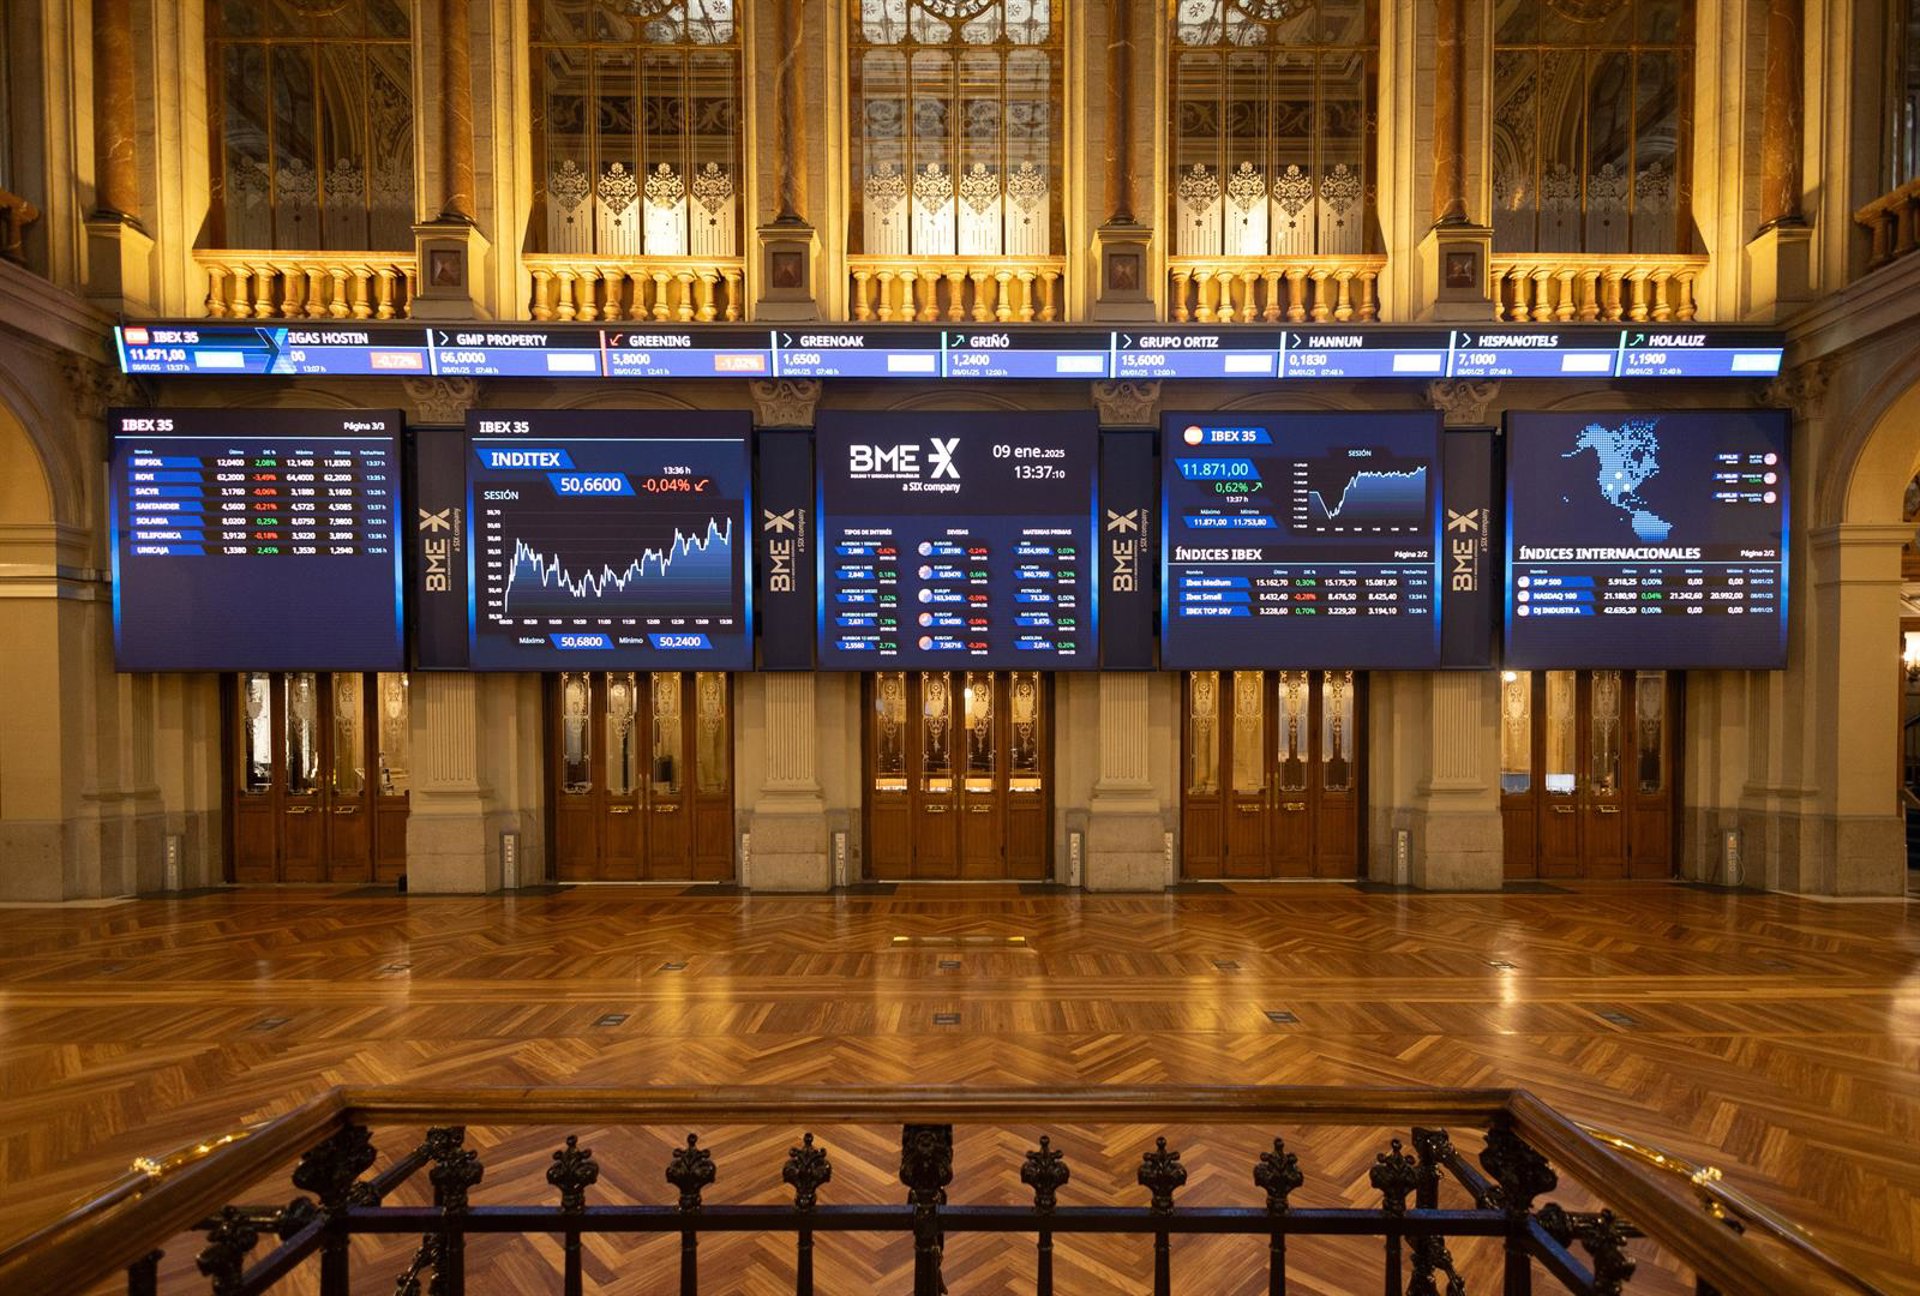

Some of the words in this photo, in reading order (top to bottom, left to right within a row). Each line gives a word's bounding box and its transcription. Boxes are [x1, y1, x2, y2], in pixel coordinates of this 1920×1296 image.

[153, 331, 182, 343] IBEX
[184, 331, 199, 343] 35
[322, 332, 368, 344] HOSTIN
[457, 334, 484, 345] GMP
[487, 334, 547, 346] PROPERTY
[629, 335, 690, 347] GREENING
[800, 335, 864, 347] GREENOAK
[970, 334, 1009, 348] GRIÑÓ
[1140, 336, 1181, 348] GRUPO
[1184, 336, 1218, 348] ORTIZ
[1309, 336, 1363, 348] HANNUN
[1479, 335, 1558, 347] HISPANOTELS
[1649, 335, 1705, 346] HOLALUZ
[130, 349, 186, 362] 11.871,00
[440, 352, 486, 364] 66,0000
[613, 353, 650, 365] 5,8000
[784, 353, 820, 366] 1,6500
[953, 354, 990, 366] 1,2400
[1121, 355, 1164, 367] 15,6000
[1290, 354, 1326, 366] 0,1830
[1459, 353, 1496, 366] 7,1000
[1628, 353, 1666, 365] 1,1900
[122, 419, 155, 431] IBEX
[157, 419, 173, 431] 35
[344, 422, 370, 432] Página
[372, 422, 385, 430] 3/3
[480, 421, 511, 433] IBEX
[513, 421, 529, 433] 35
[1211, 430, 1239, 442] IBEX
[1242, 430, 1256, 442] 35
[993, 444, 1010, 458] 09
[1348, 449, 1371, 457] SESIÓN
[491, 452, 560, 467] INDITEX
[850, 444, 920, 472] BME
[663, 466, 684, 474] 13:36
[685, 466, 691, 474] h
[1014, 465, 1065, 479] 13:37:10
[1184, 463, 1248, 478] 11.871,00
[135, 473, 154, 481] ROVI
[561, 477, 621, 494] 50,6600
[642, 478, 690, 493] -0,04%
[909, 482, 923, 491] SIX
[924, 483, 960, 494] company
[1216, 482, 1248, 494] 0,62%
[484, 489, 519, 500] SESIÓN
[254, 503, 277, 511] -0,21%
[136, 517, 168, 525] SOLARIA
[137, 547, 169, 555] UNICAJA
[1175, 546, 1229, 560] ÍNDICES
[1231, 549, 1262, 560] IBEX
[1394, 551, 1416, 559] Página
[1519, 545, 1573, 560] ÍNDICES
[1576, 548, 1700, 560] INTERNACIONALES
[1740, 549, 1763, 558] Página
[425, 538, 446, 592] BME
[769, 539, 790, 592] BME
[1112, 539, 1133, 592] BME
[1452, 539, 1473, 592] BME
[1325, 579, 1356, 587] 15.175,70
[1642, 578, 1662, 586] 0,00%
[1688, 578, 1703, 586] 0,00
[1728, 578, 1743, 586] 0,00
[1296, 607, 1315, 615] 0,70%
[1687, 606, 1702, 614] 0,00
[1728, 606, 1743, 614] 0,00
[519, 636, 545, 644] Máximo
[561, 636, 602, 648] 50,6800
[619, 636, 644, 644] Mínimo
[660, 636, 701, 648] 50,2400
